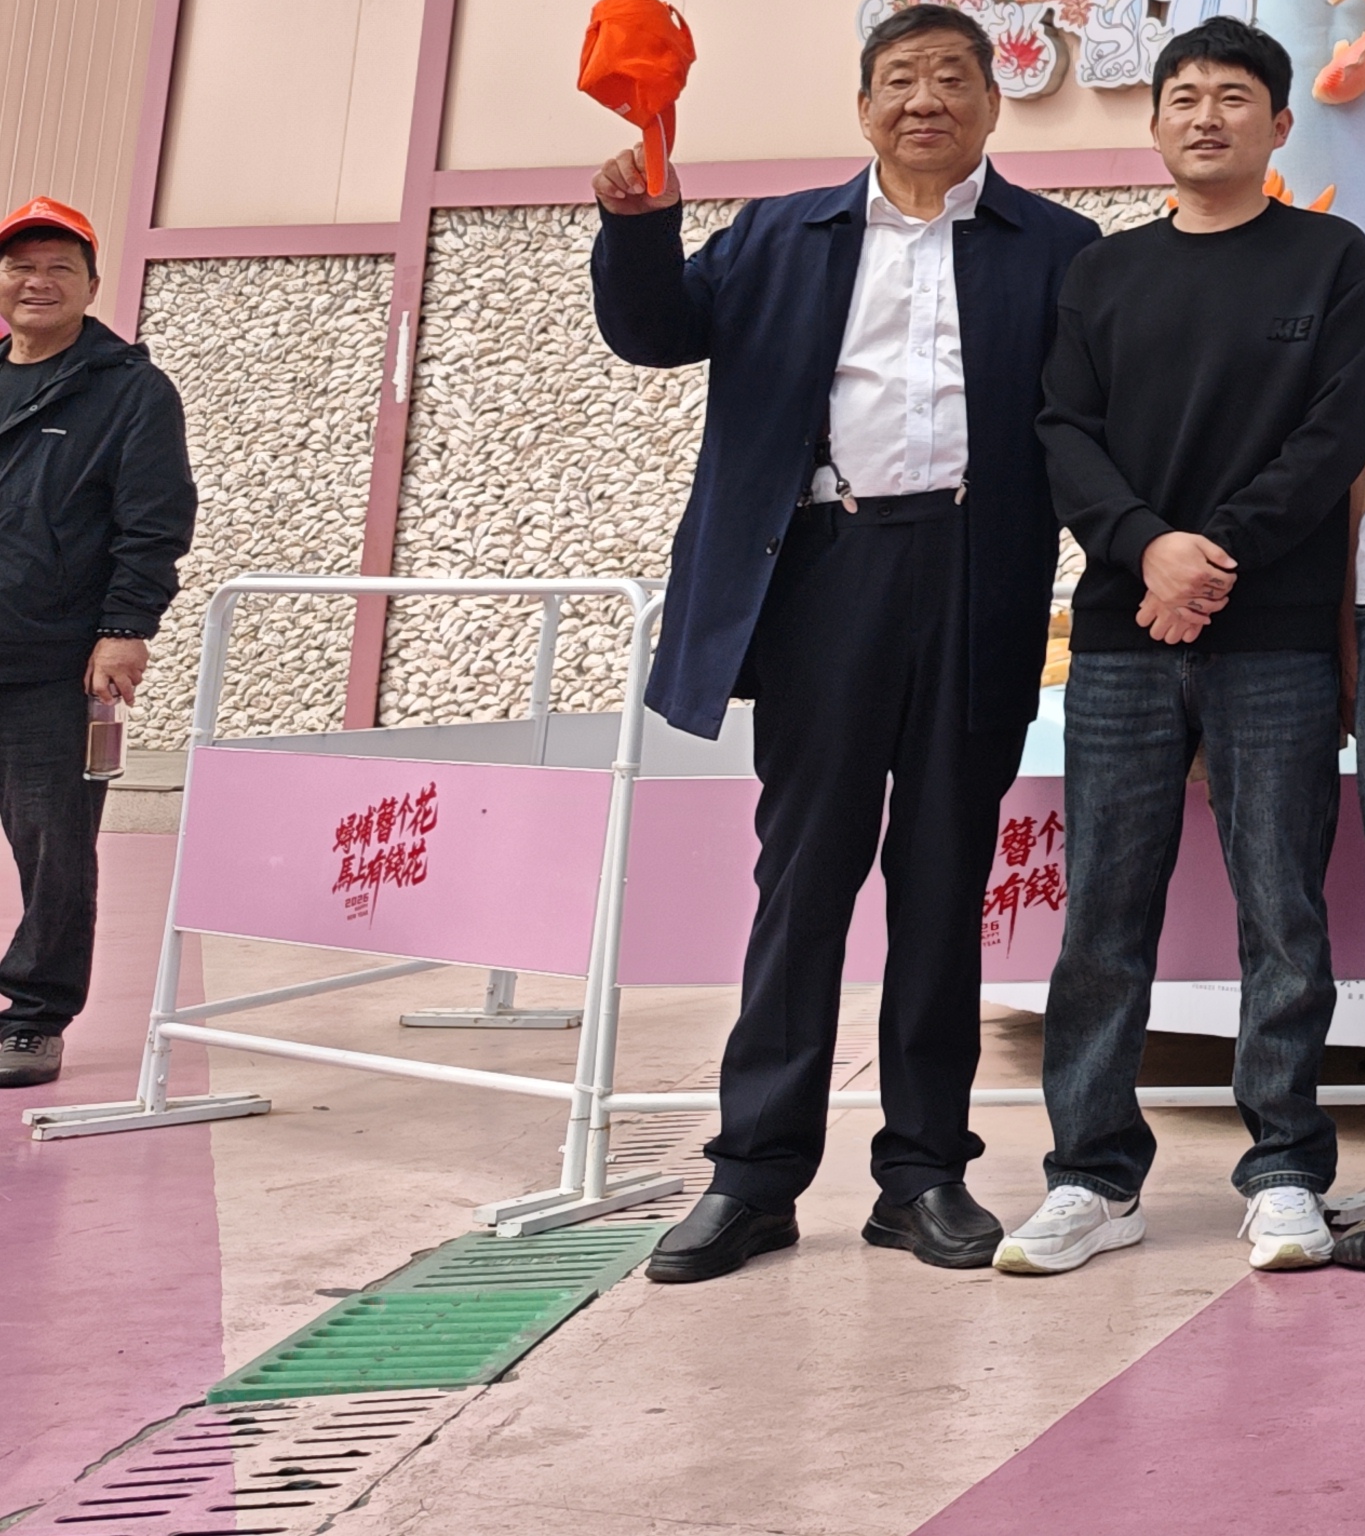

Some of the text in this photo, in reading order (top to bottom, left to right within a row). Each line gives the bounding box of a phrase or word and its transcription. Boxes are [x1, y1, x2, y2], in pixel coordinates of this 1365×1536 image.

[998, 810, 1065, 867] 簪个
[332, 838, 429, 930] 馬上有錢花
[345, 893, 369, 908] 2026
